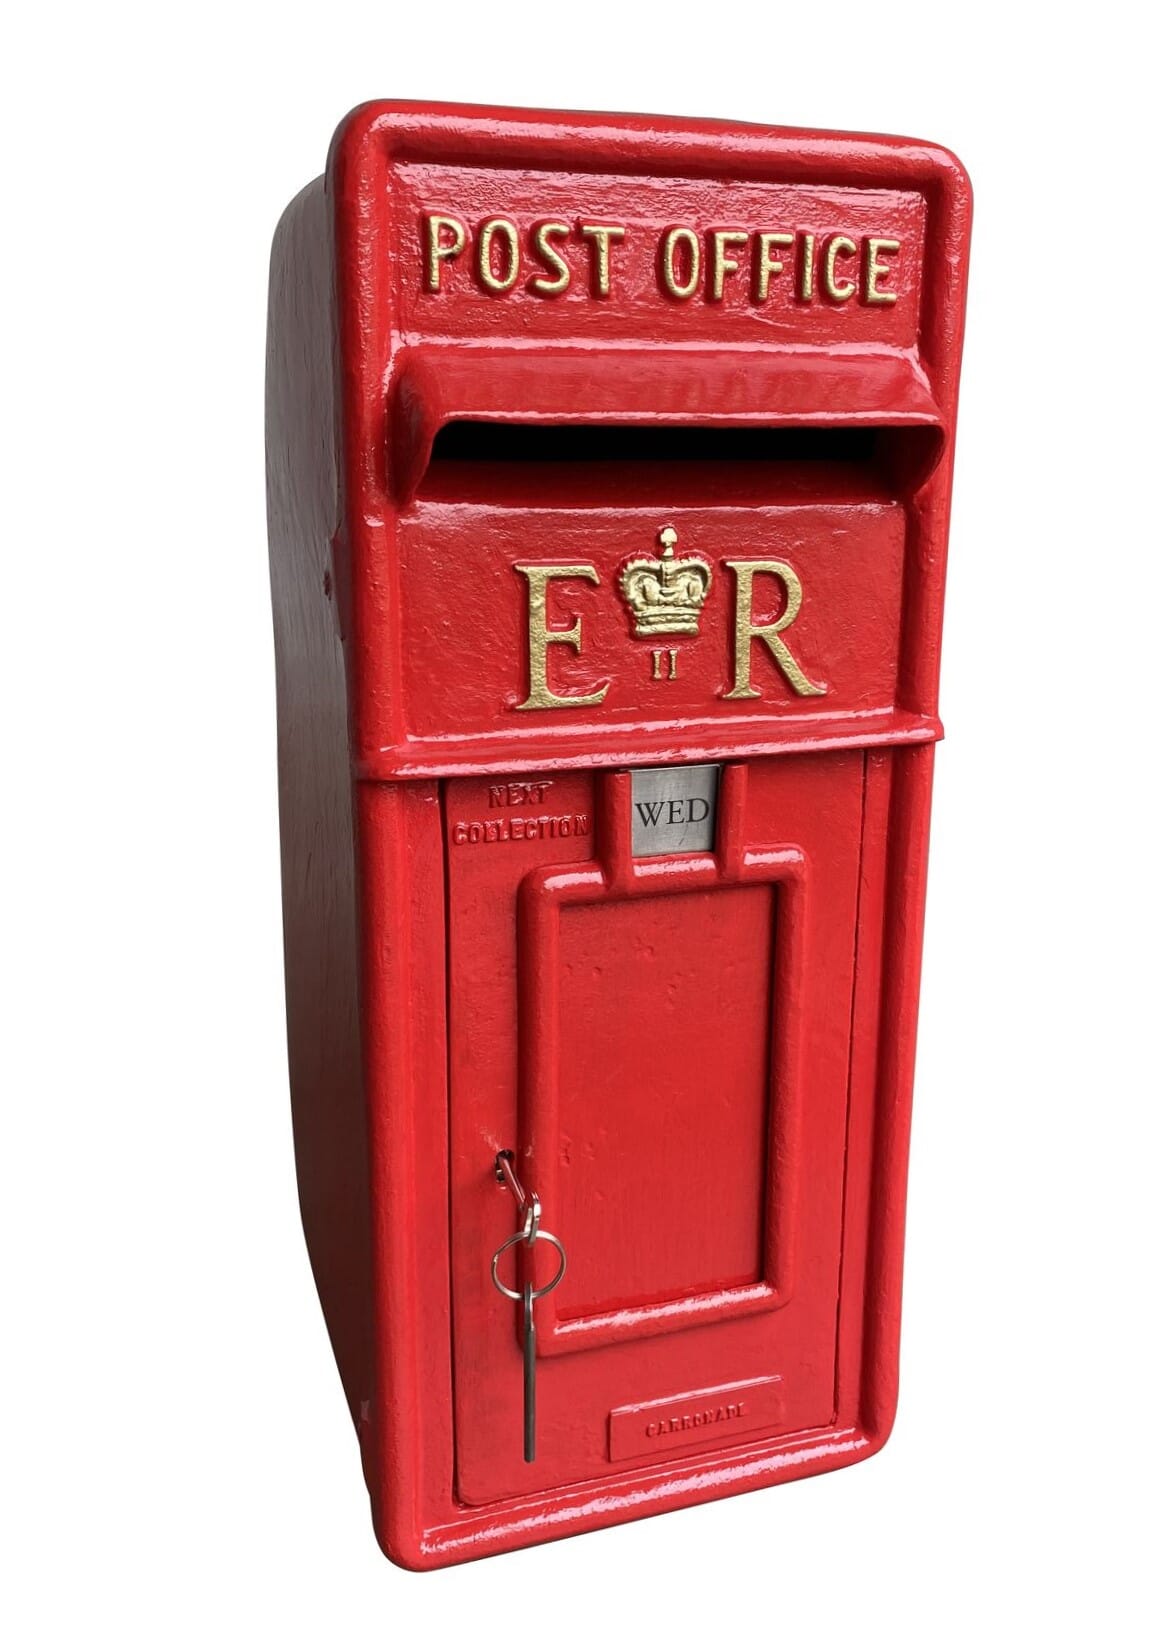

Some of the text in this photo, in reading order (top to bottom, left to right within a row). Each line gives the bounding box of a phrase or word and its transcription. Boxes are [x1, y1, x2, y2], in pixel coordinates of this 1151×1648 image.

[426, 215, 901, 303] POST OFFICE
[514, 560, 828, 711] E R
[652, 649, 678, 680] II
[487, 780, 553, 808] NEXT
[634, 797, 710, 828] WED
[451, 814, 590, 846] COLLECTION
